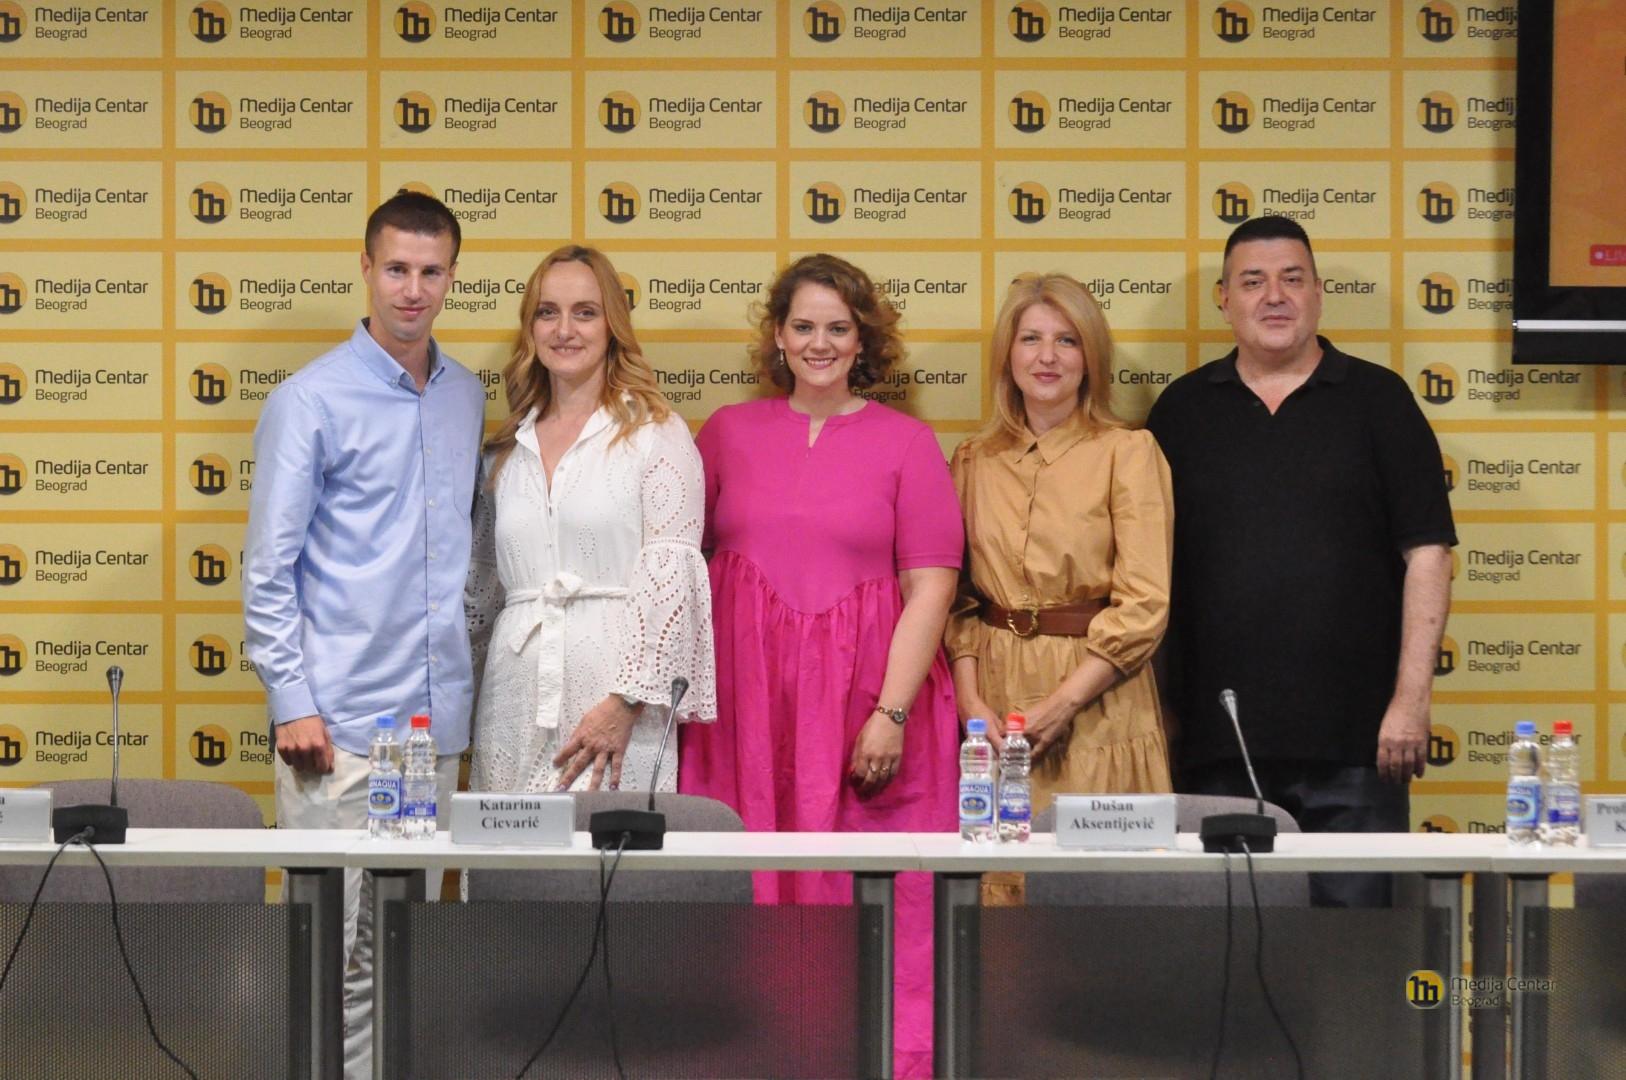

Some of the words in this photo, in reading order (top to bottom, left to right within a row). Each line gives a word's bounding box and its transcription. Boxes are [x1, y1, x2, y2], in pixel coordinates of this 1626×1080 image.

[35, 8, 91, 24] Medija
[96, 8, 148, 22] Centar
[240, 8, 296, 24] Medija
[300, 8, 353, 22] Centar
[444, 8, 500, 24] Medija
[505, 8, 558, 22] Centar
[649, 8, 705, 24] Medija
[710, 8, 763, 22] Centar
[854, 8, 910, 24] Medija
[914, 8, 967, 22] Centar
[1058, 8, 1114, 24] Medija
[1119, 8, 1172, 22] Centar
[1263, 8, 1319, 24] Medija
[1324, 8, 1377, 22] Centar
[35, 27, 88, 41] Beograd
[240, 27, 292, 41] Beograd
[444, 27, 497, 41] Beograd
[649, 27, 702, 41] Beograd
[854, 27, 906, 41] Beograd
[1058, 27, 1111, 41] Beograd
[1263, 27, 1316, 41] Beograd
[35, 98, 91, 115] Medija
[96, 98, 148, 112] Centar
[240, 98, 296, 115] Medija
[300, 98, 353, 112] Centar
[444, 98, 500, 115] Medija
[505, 98, 558, 112] Centar
[649, 98, 705, 115] Medija
[710, 98, 763, 112] Centar
[854, 98, 910, 115] Medija
[914, 98, 967, 112] Centar
[1058, 98, 1114, 115] Medija
[1119, 98, 1172, 112] Centar
[1263, 98, 1319, 115] Medija
[1324, 98, 1377, 112] Centar
[1467, 97, 1514, 115] Medij
[35, 117, 88, 131] Beograd
[240, 117, 292, 131] Beograd
[444, 117, 497, 131] Beograd
[649, 117, 702, 131] Beograd
[854, 117, 906, 131] Beograd
[1058, 117, 1111, 131] Beograd
[1263, 117, 1316, 131] Beograd
[1467, 117, 1515, 131] Beogra
[35, 188, 91, 205] Medija
[96, 188, 148, 203] Centar
[240, 188, 296, 205] Medija
[300, 188, 353, 203] Centar
[444, 188, 500, 205] Medija
[505, 188, 558, 203] Centar
[649, 188, 705, 205] Medija
[710, 188, 763, 203] Centar
[854, 188, 910, 205] Medija
[914, 188, 967, 203] Centar
[1058, 188, 1114, 205] Medija
[1119, 188, 1172, 203] Centar
[1263, 188, 1319, 205] Medija
[1324, 188, 1377, 203] Centar
[1468, 188, 1514, 206] Medij
[35, 208, 88, 222] Beograd
[240, 208, 292, 222] Beograd
[649, 208, 702, 222] Beograd
[854, 208, 906, 222] Beograd
[1058, 208, 1111, 222] Beograd
[1468, 208, 1514, 222] Beogra
[35, 279, 91, 296] Medija
[96, 279, 148, 293] Centar
[240, 279, 296, 296] Medija
[300, 279, 353, 293] Centar
[649, 279, 705, 296] Medija
[710, 279, 763, 293] Centar
[874, 279, 910, 297] edija
[914, 279, 967, 293] Centar
[1081, 279, 1114, 297] dija
[1119, 279, 1172, 293] Centar
[1324, 279, 1377, 293] Centar
[35, 298, 88, 312] Beograd
[240, 298, 292, 312] Beograd
[444, 298, 497, 312] Beograd
[649, 298, 702, 312] Beograd
[1468, 298, 1513, 312] Beogra
[35, 369, 91, 386] Medija
[96, 369, 148, 384] Centar
[240, 369, 293, 385] Medij
[914, 369, 967, 384] Centar
[1119, 369, 1172, 384] Centar
[1468, 369, 1524, 386] Medija
[1528, 369, 1581, 384] Centar
[35, 389, 88, 403] Beograd
[662, 389, 701, 403] ograd
[1468, 389, 1520, 403] Beograd
[35, 460, 91, 477] Medija
[96, 460, 148, 474] Centar
[1468, 460, 1524, 477] Medija
[1528, 460, 1581, 474] Centar
[35, 479, 88, 493] Beograd
[1468, 479, 1520, 493] Beograd
[35, 550, 91, 567] Medija
[96, 550, 148, 565] Centar
[1468, 550, 1524, 567] Medija
[1528, 550, 1581, 565] Centar
[35, 570, 88, 584] Beograd
[1468, 570, 1520, 584] Beograd
[35, 640, 91, 657] Medija
[96, 640, 148, 655] Centar
[1468, 640, 1524, 657] Medija
[1528, 640, 1581, 655] Centar
[35, 660, 88, 674] Beograd
[1468, 660, 1520, 674] Beograd
[35, 731, 91, 748] Medija
[96, 731, 148, 745] Centar
[35, 750, 88, 764] Beograd
[479, 799, 541, 811] Katarina
[1091, 800, 1134, 812] Dušan
[1071, 816, 1155, 832] Aksentijević
